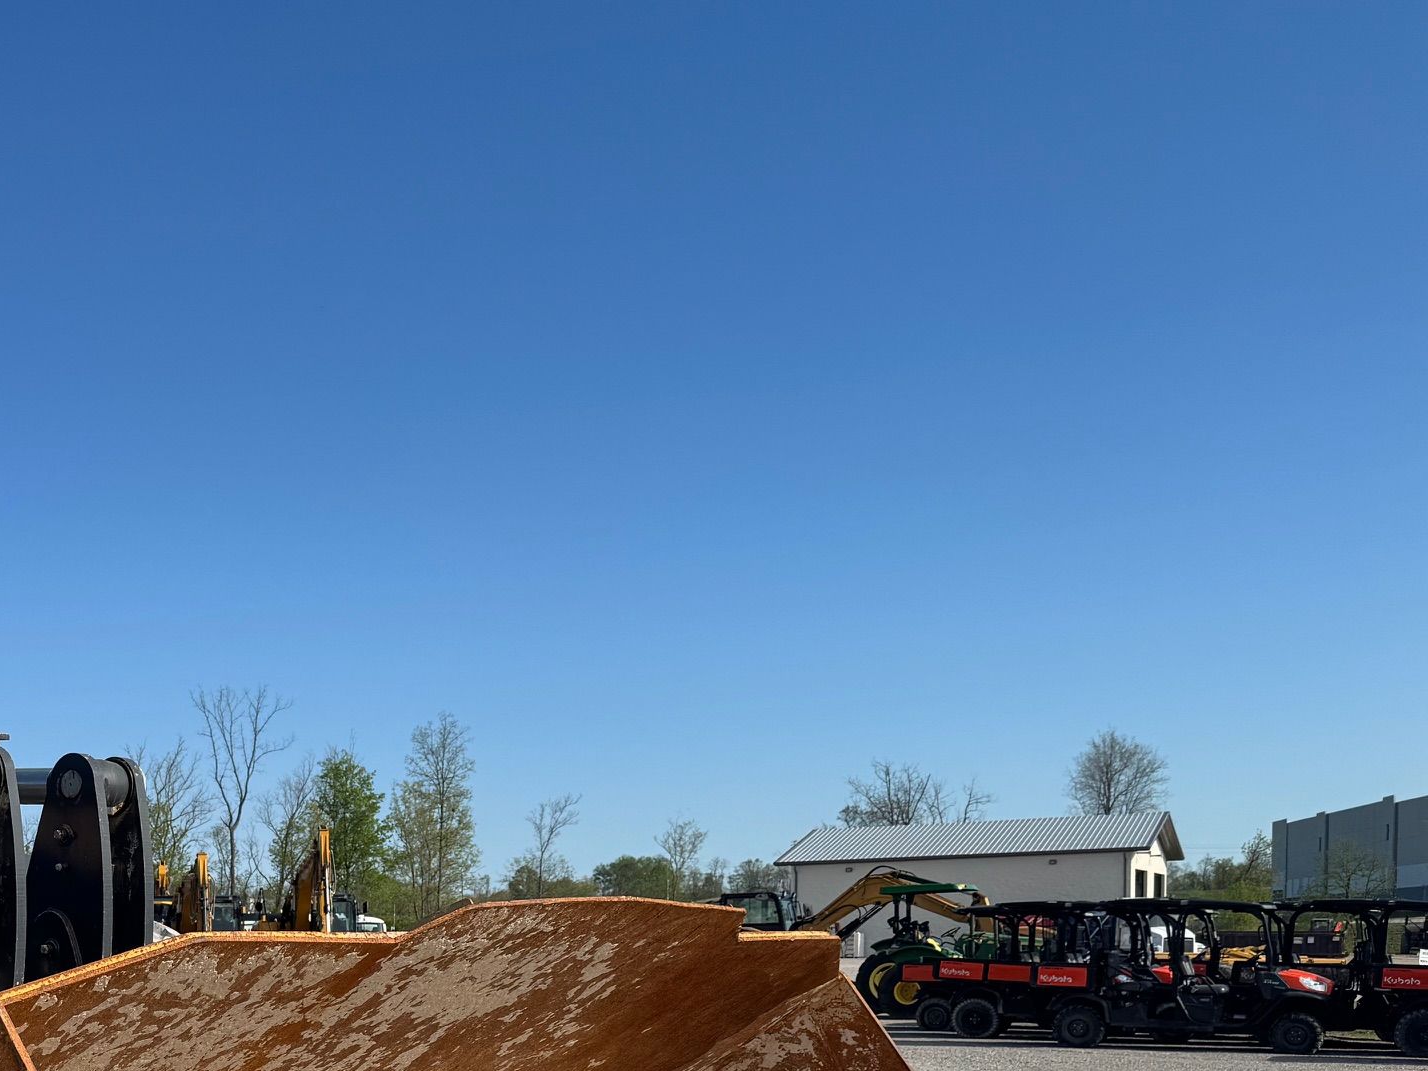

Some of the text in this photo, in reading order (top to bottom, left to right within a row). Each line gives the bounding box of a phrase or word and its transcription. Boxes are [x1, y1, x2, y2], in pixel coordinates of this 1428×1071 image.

[940, 966, 971, 977] Kubota
[1040, 974, 1073, 984] Kubota
[1384, 976, 1421, 986] Kubota
